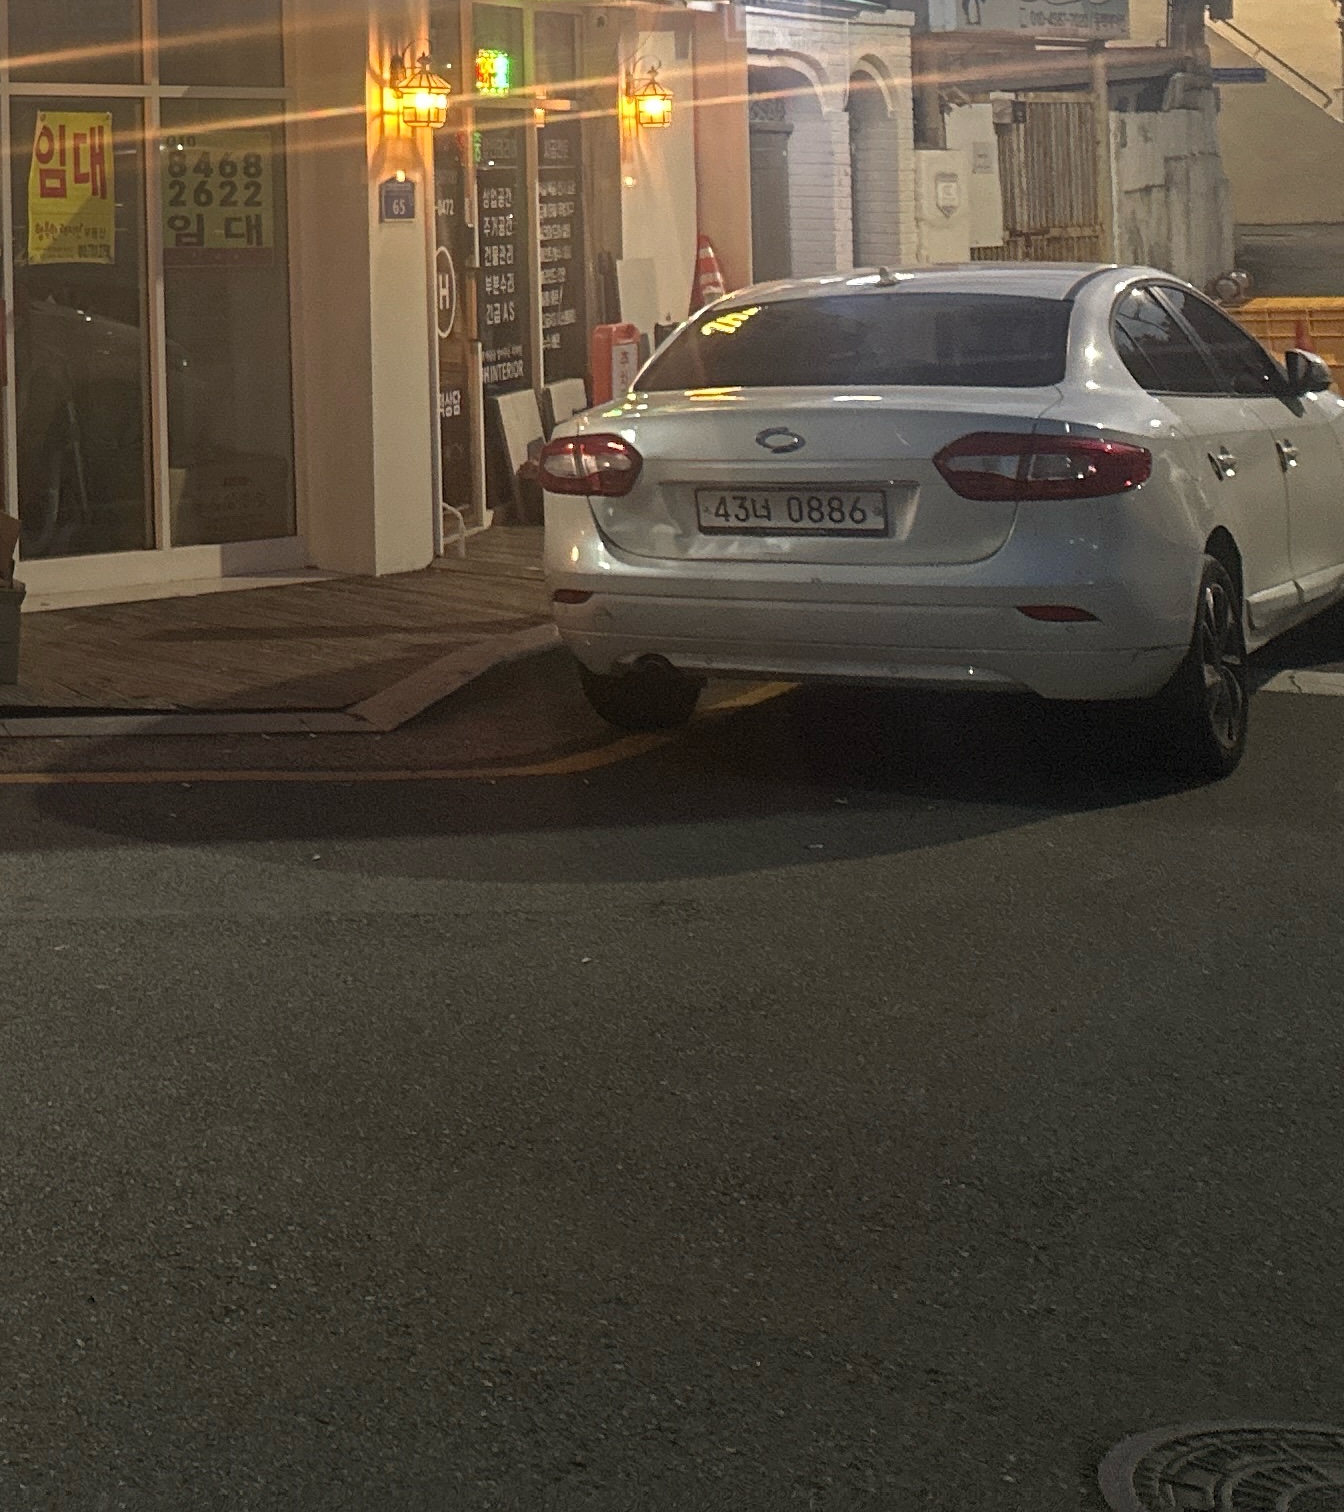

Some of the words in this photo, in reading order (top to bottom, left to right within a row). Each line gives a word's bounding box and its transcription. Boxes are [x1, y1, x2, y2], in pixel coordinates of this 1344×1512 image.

[35, 124, 107, 200] 임대
[167, 151, 263, 179] 8468
[167, 180, 263, 207] 2622
[393, 199, 406, 215] 65
[786, 495, 867, 525] 0886
